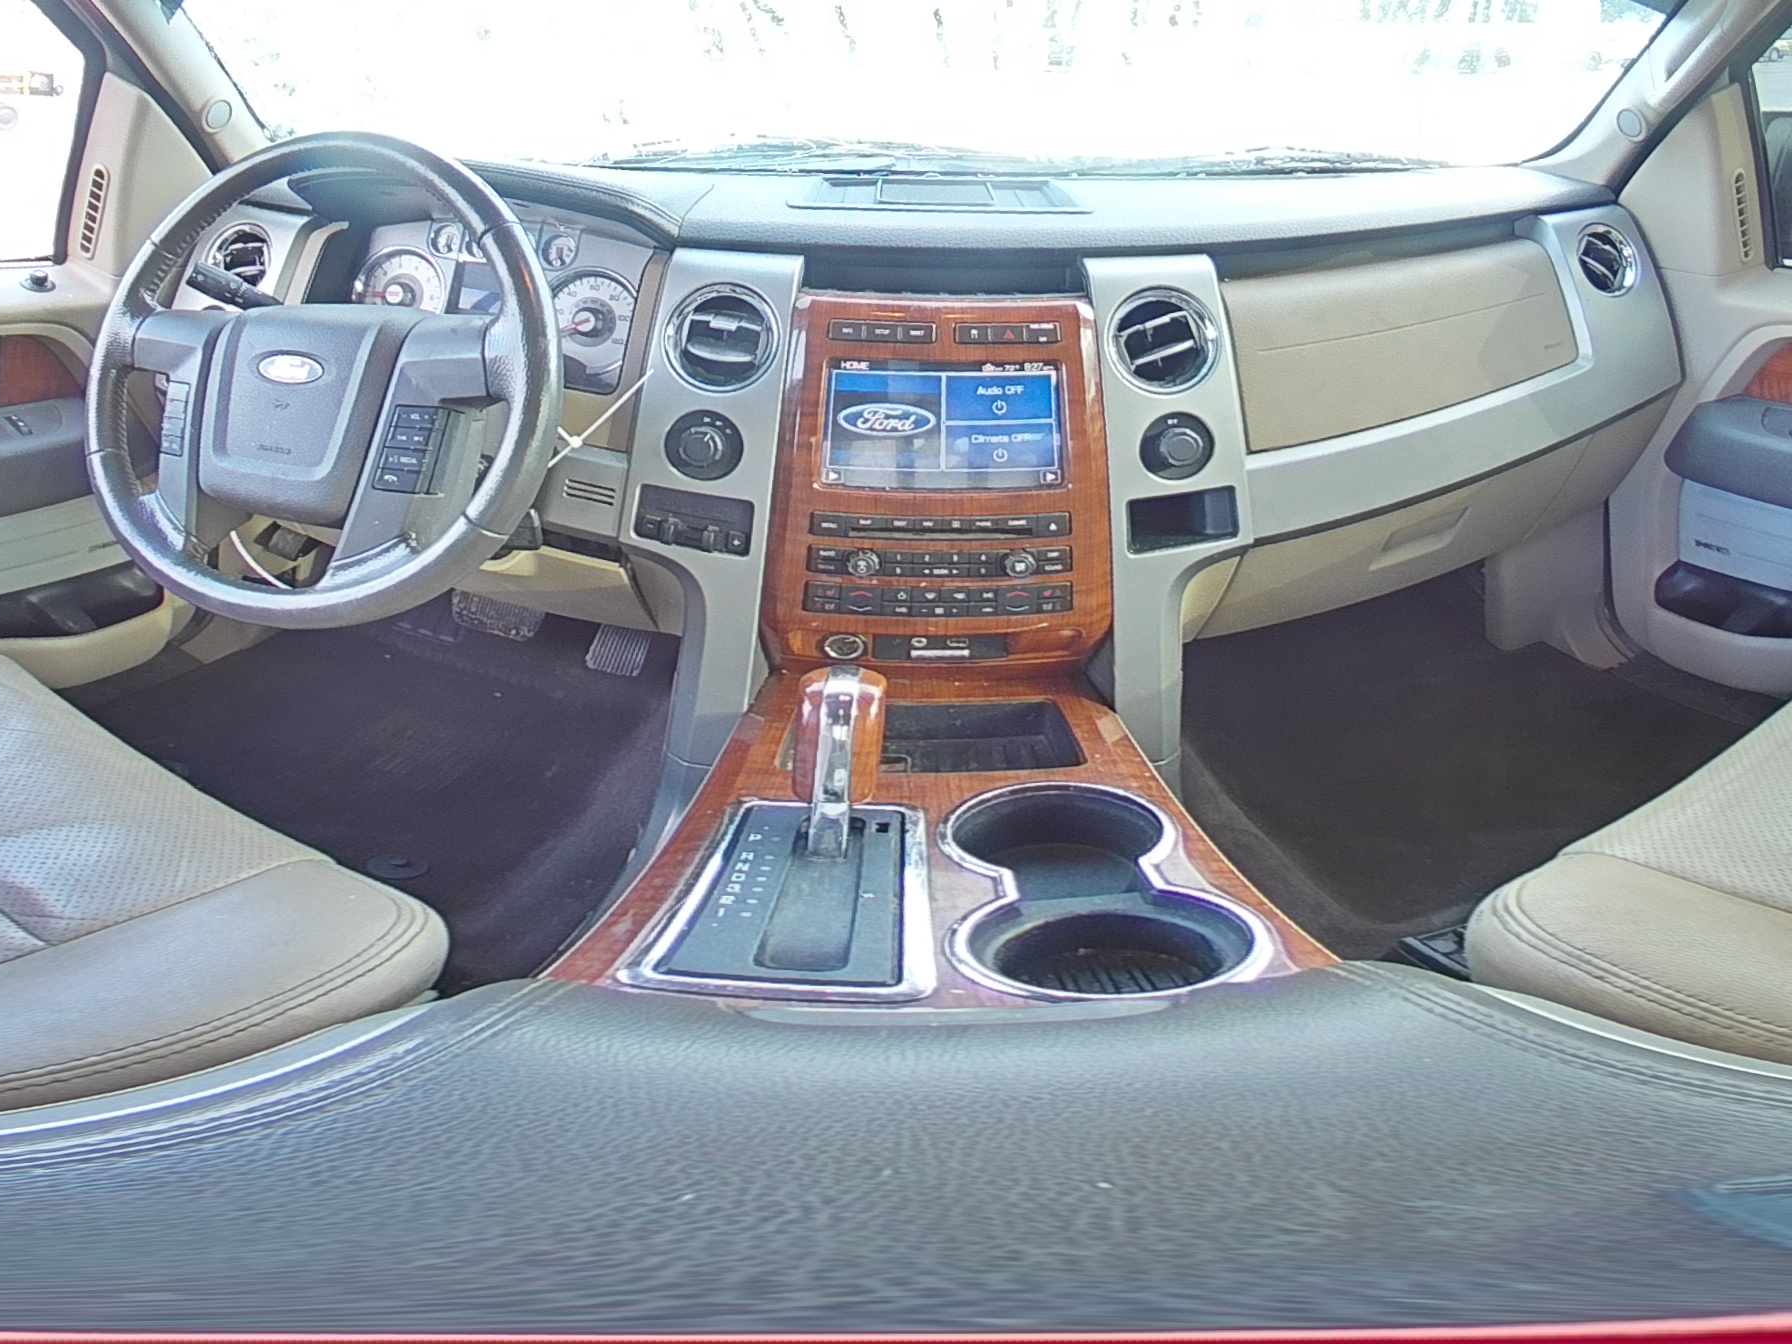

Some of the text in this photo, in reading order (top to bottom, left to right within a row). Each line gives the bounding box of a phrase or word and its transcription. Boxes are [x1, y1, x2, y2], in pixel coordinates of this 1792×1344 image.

[589, 283, 601, 292] 60
[841, 361, 870, 370] HOME
[976, 385, 1024, 395] Audio OFF
[856, 407, 917, 431] Ford
[971, 434, 1009, 443] Climate
[748, 833, 763, 842] P
[740, 851, 754, 860] R
[734, 862, 750, 871] N
[731, 872, 746, 881] D
